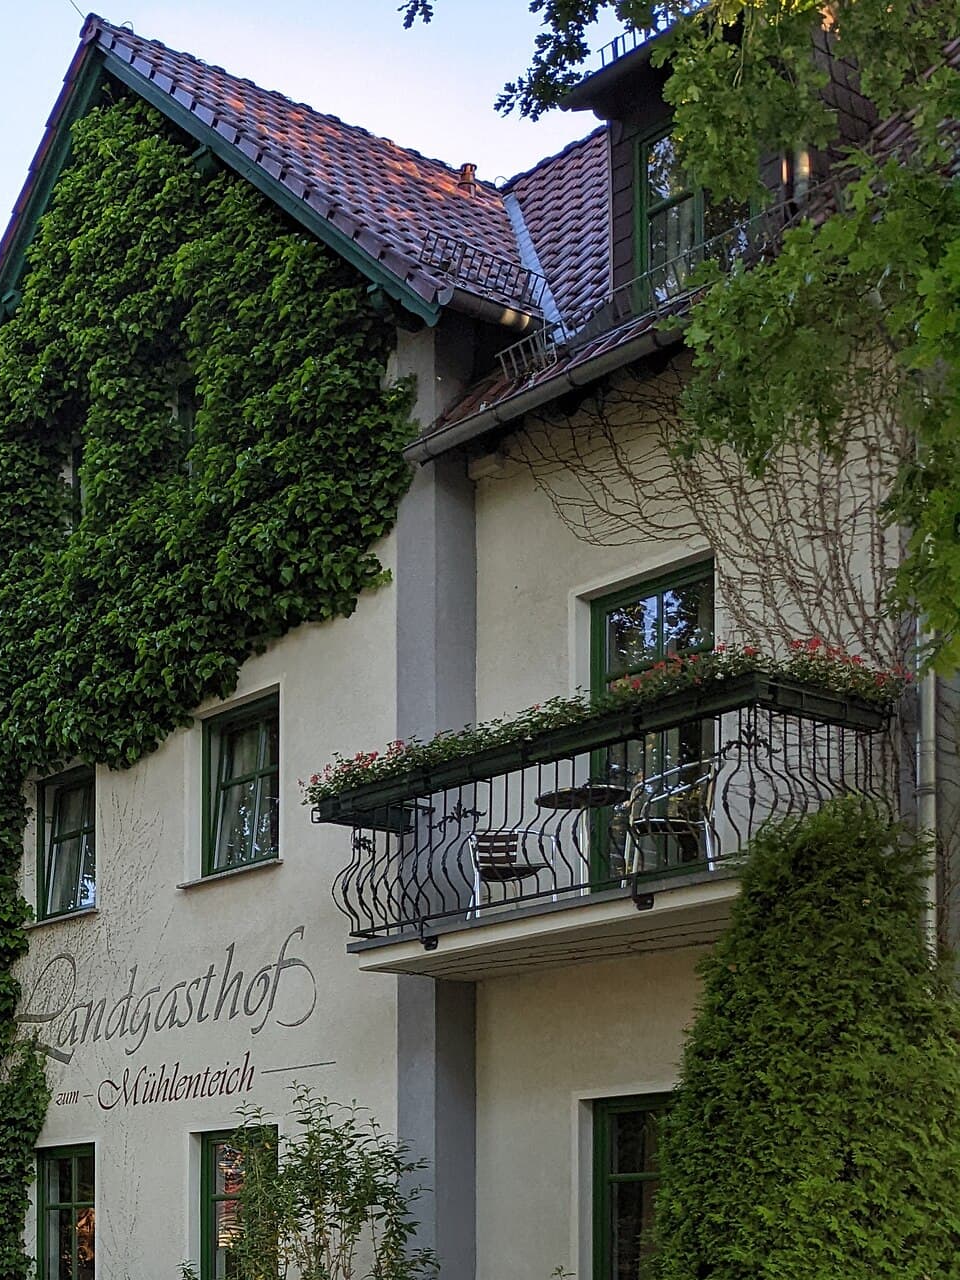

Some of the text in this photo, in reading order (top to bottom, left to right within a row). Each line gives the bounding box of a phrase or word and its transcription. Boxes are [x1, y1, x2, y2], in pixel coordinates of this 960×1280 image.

[14, 925, 317, 1065] Landgasthof
[55, 1051, 255, 1110] zum Mühlenteich
